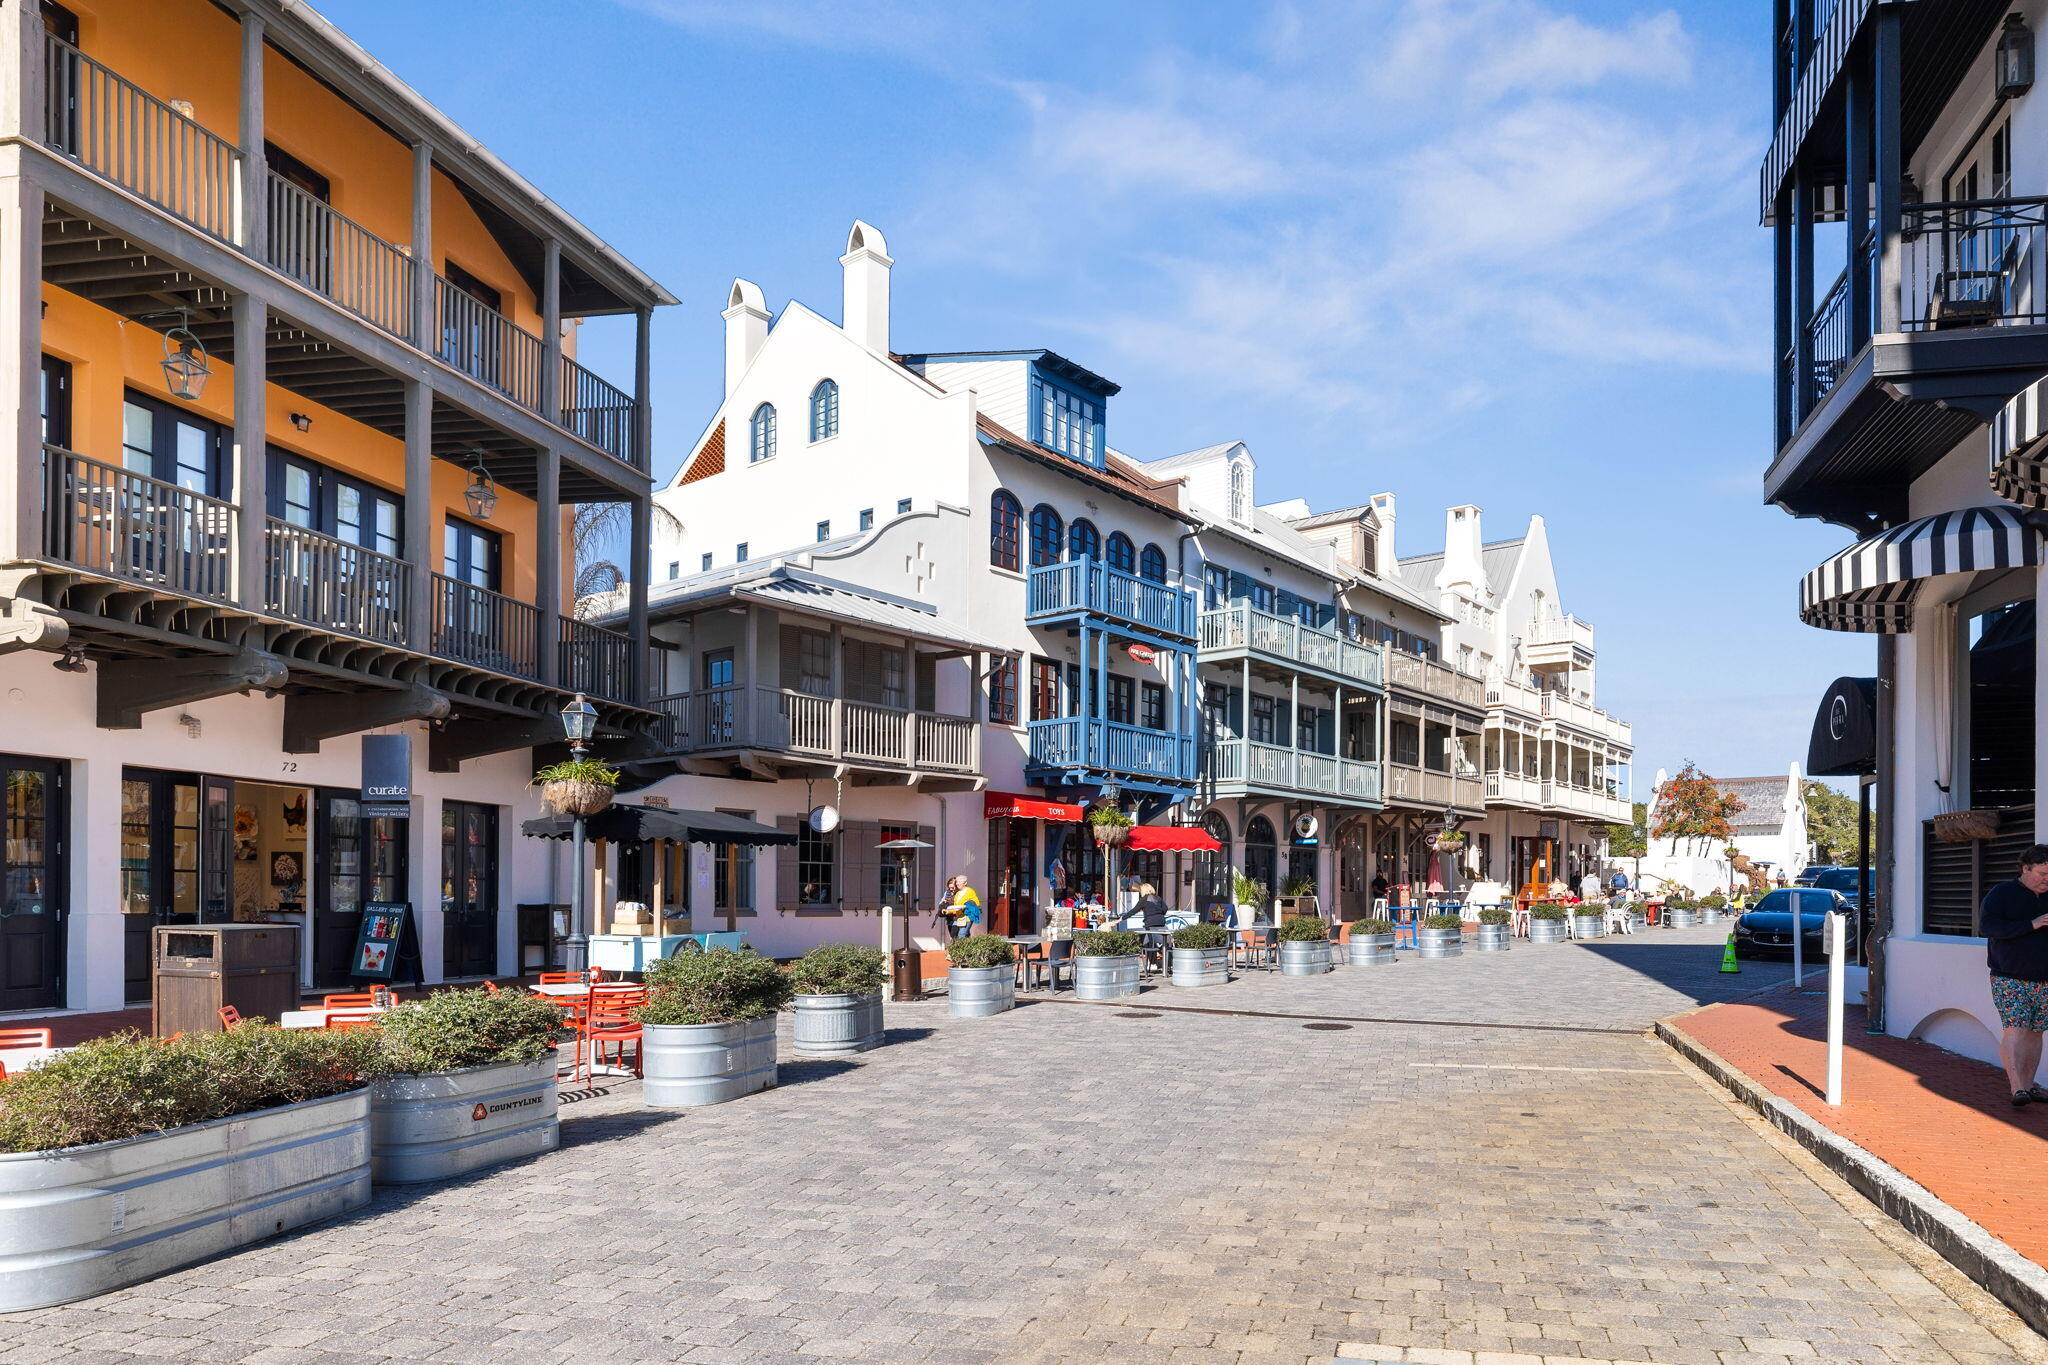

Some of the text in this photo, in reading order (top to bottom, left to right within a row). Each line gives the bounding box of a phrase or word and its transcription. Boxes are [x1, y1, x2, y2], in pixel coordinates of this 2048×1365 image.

[282, 762, 297, 773] 72
[368, 785, 407, 796] curate
[1047, 807, 1065, 816] TOYS
[489, 1096, 544, 1113] COUNTYLINE
